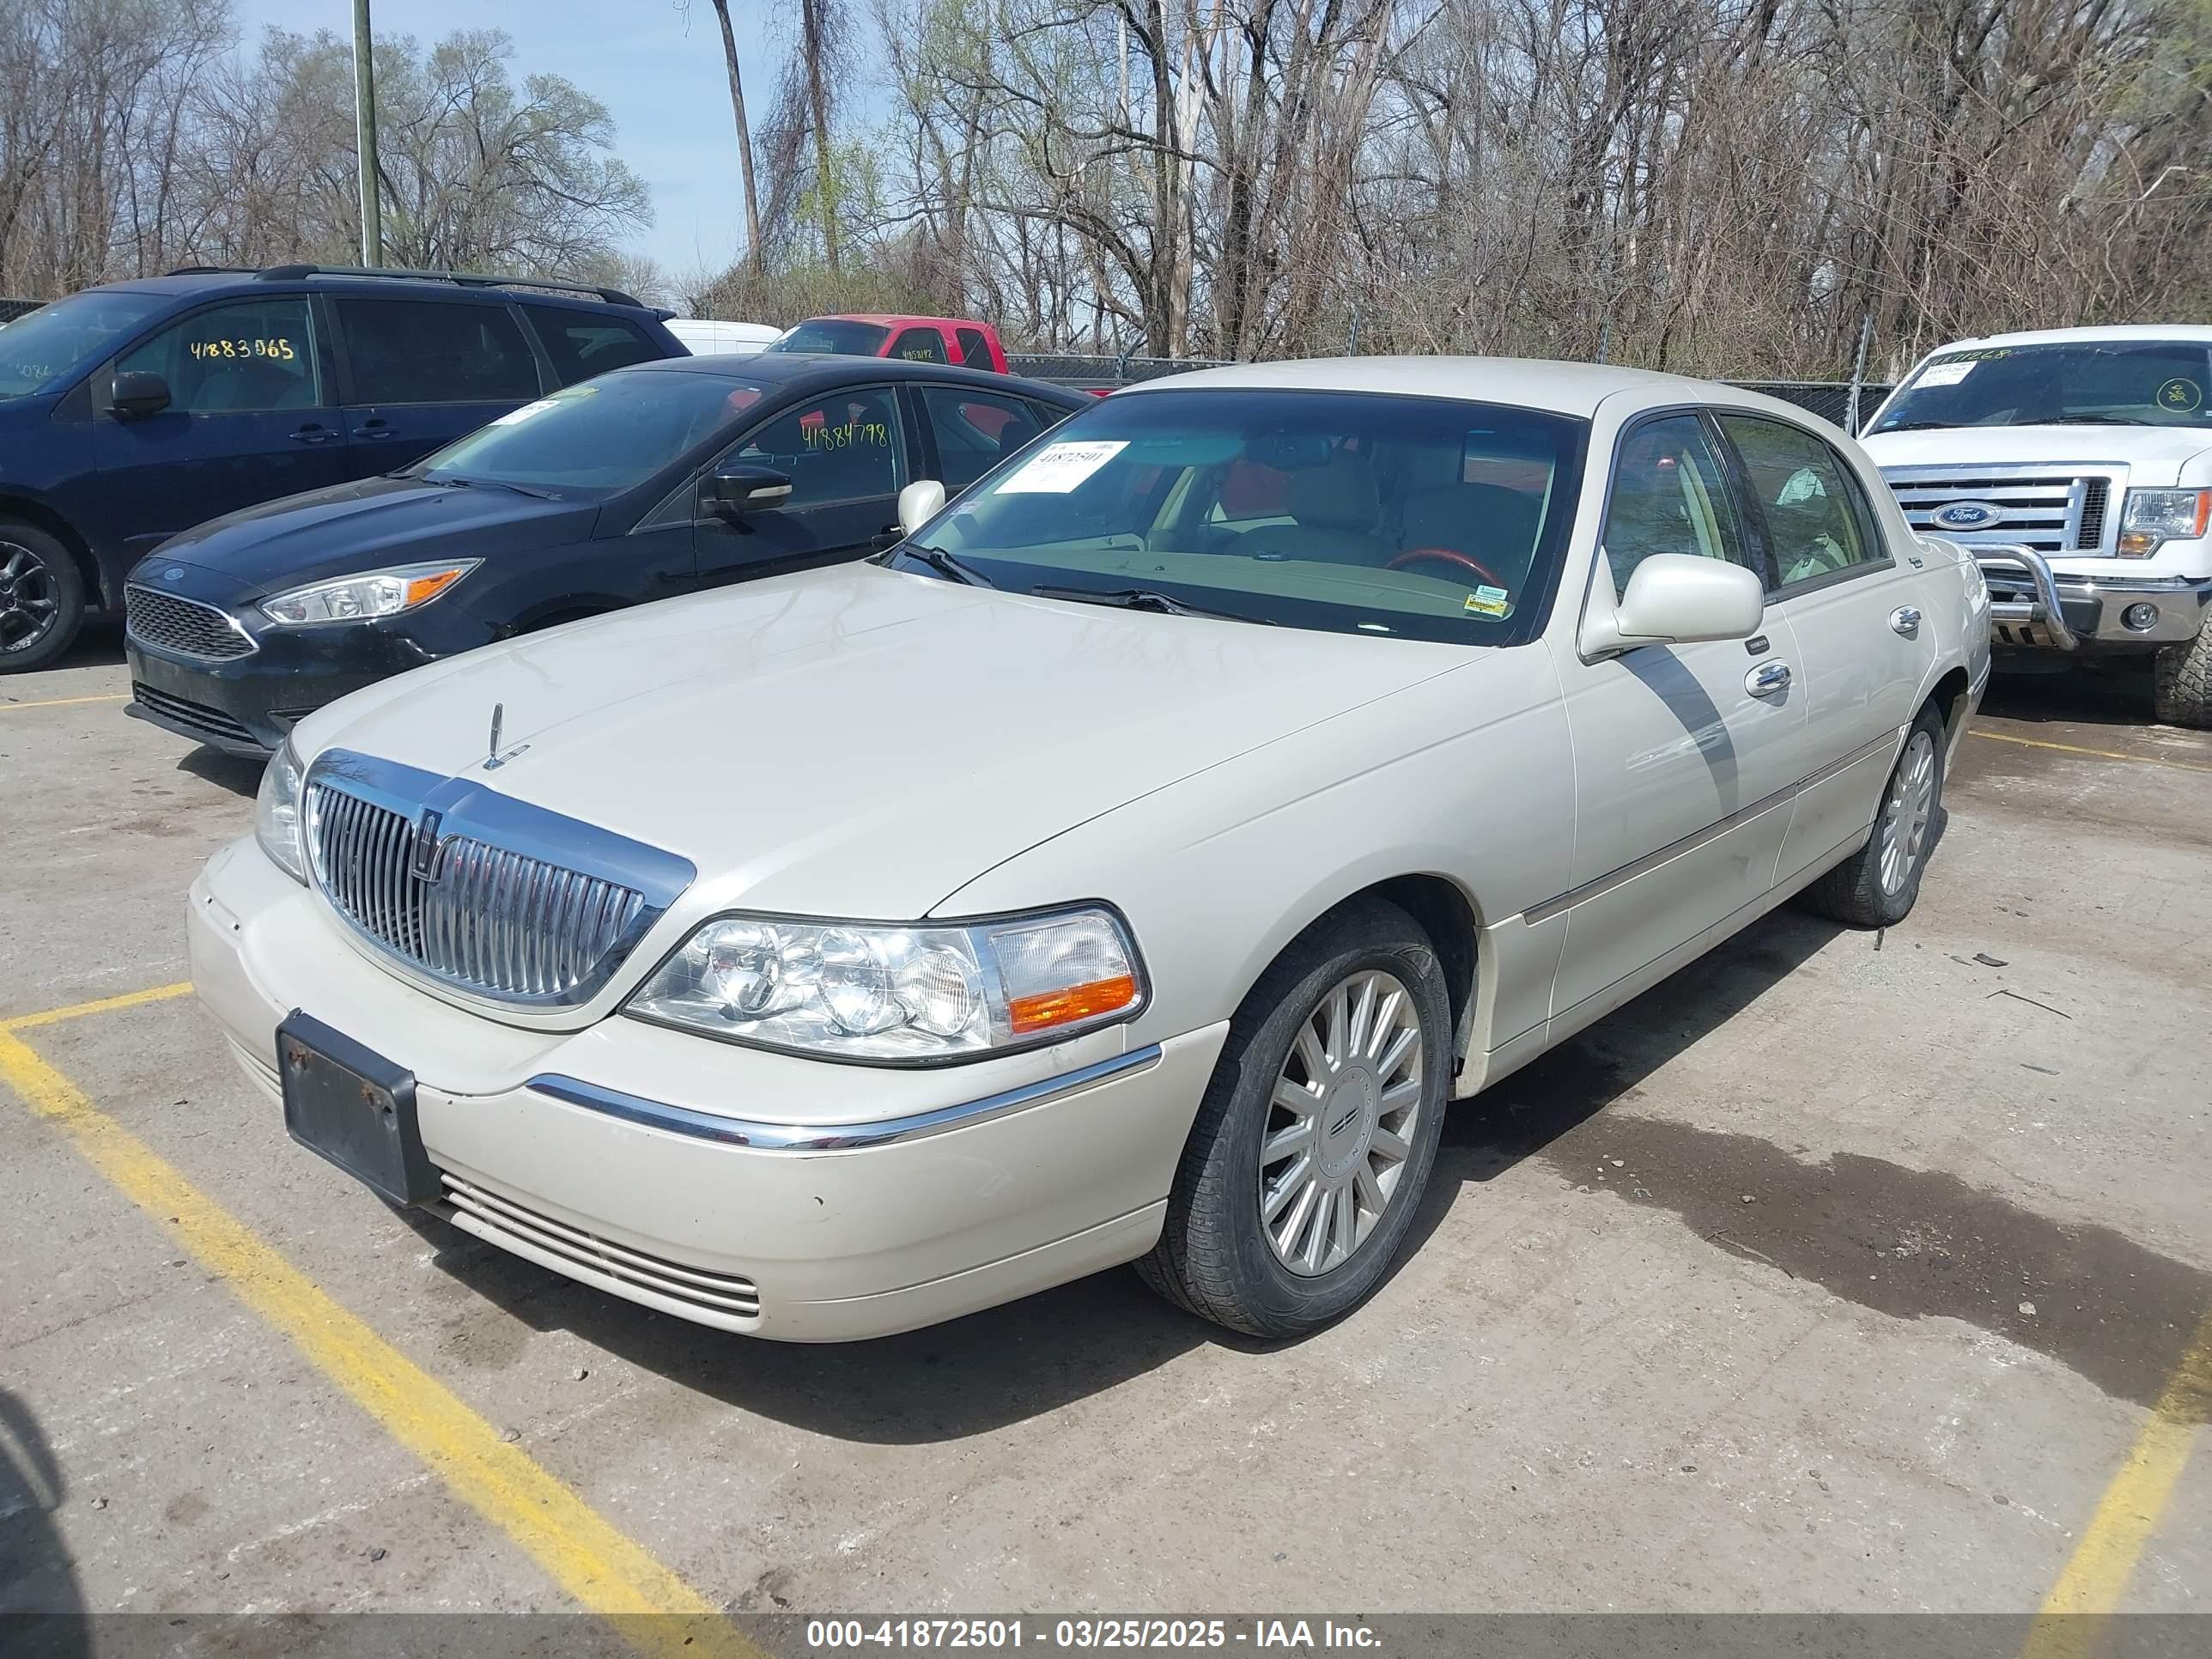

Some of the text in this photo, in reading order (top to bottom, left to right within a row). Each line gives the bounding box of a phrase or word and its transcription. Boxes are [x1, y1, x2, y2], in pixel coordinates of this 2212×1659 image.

[801, 422, 888, 451] 41884798
[1040, 452, 1104, 463] 41872501
[1950, 508, 1980, 520] Ford
